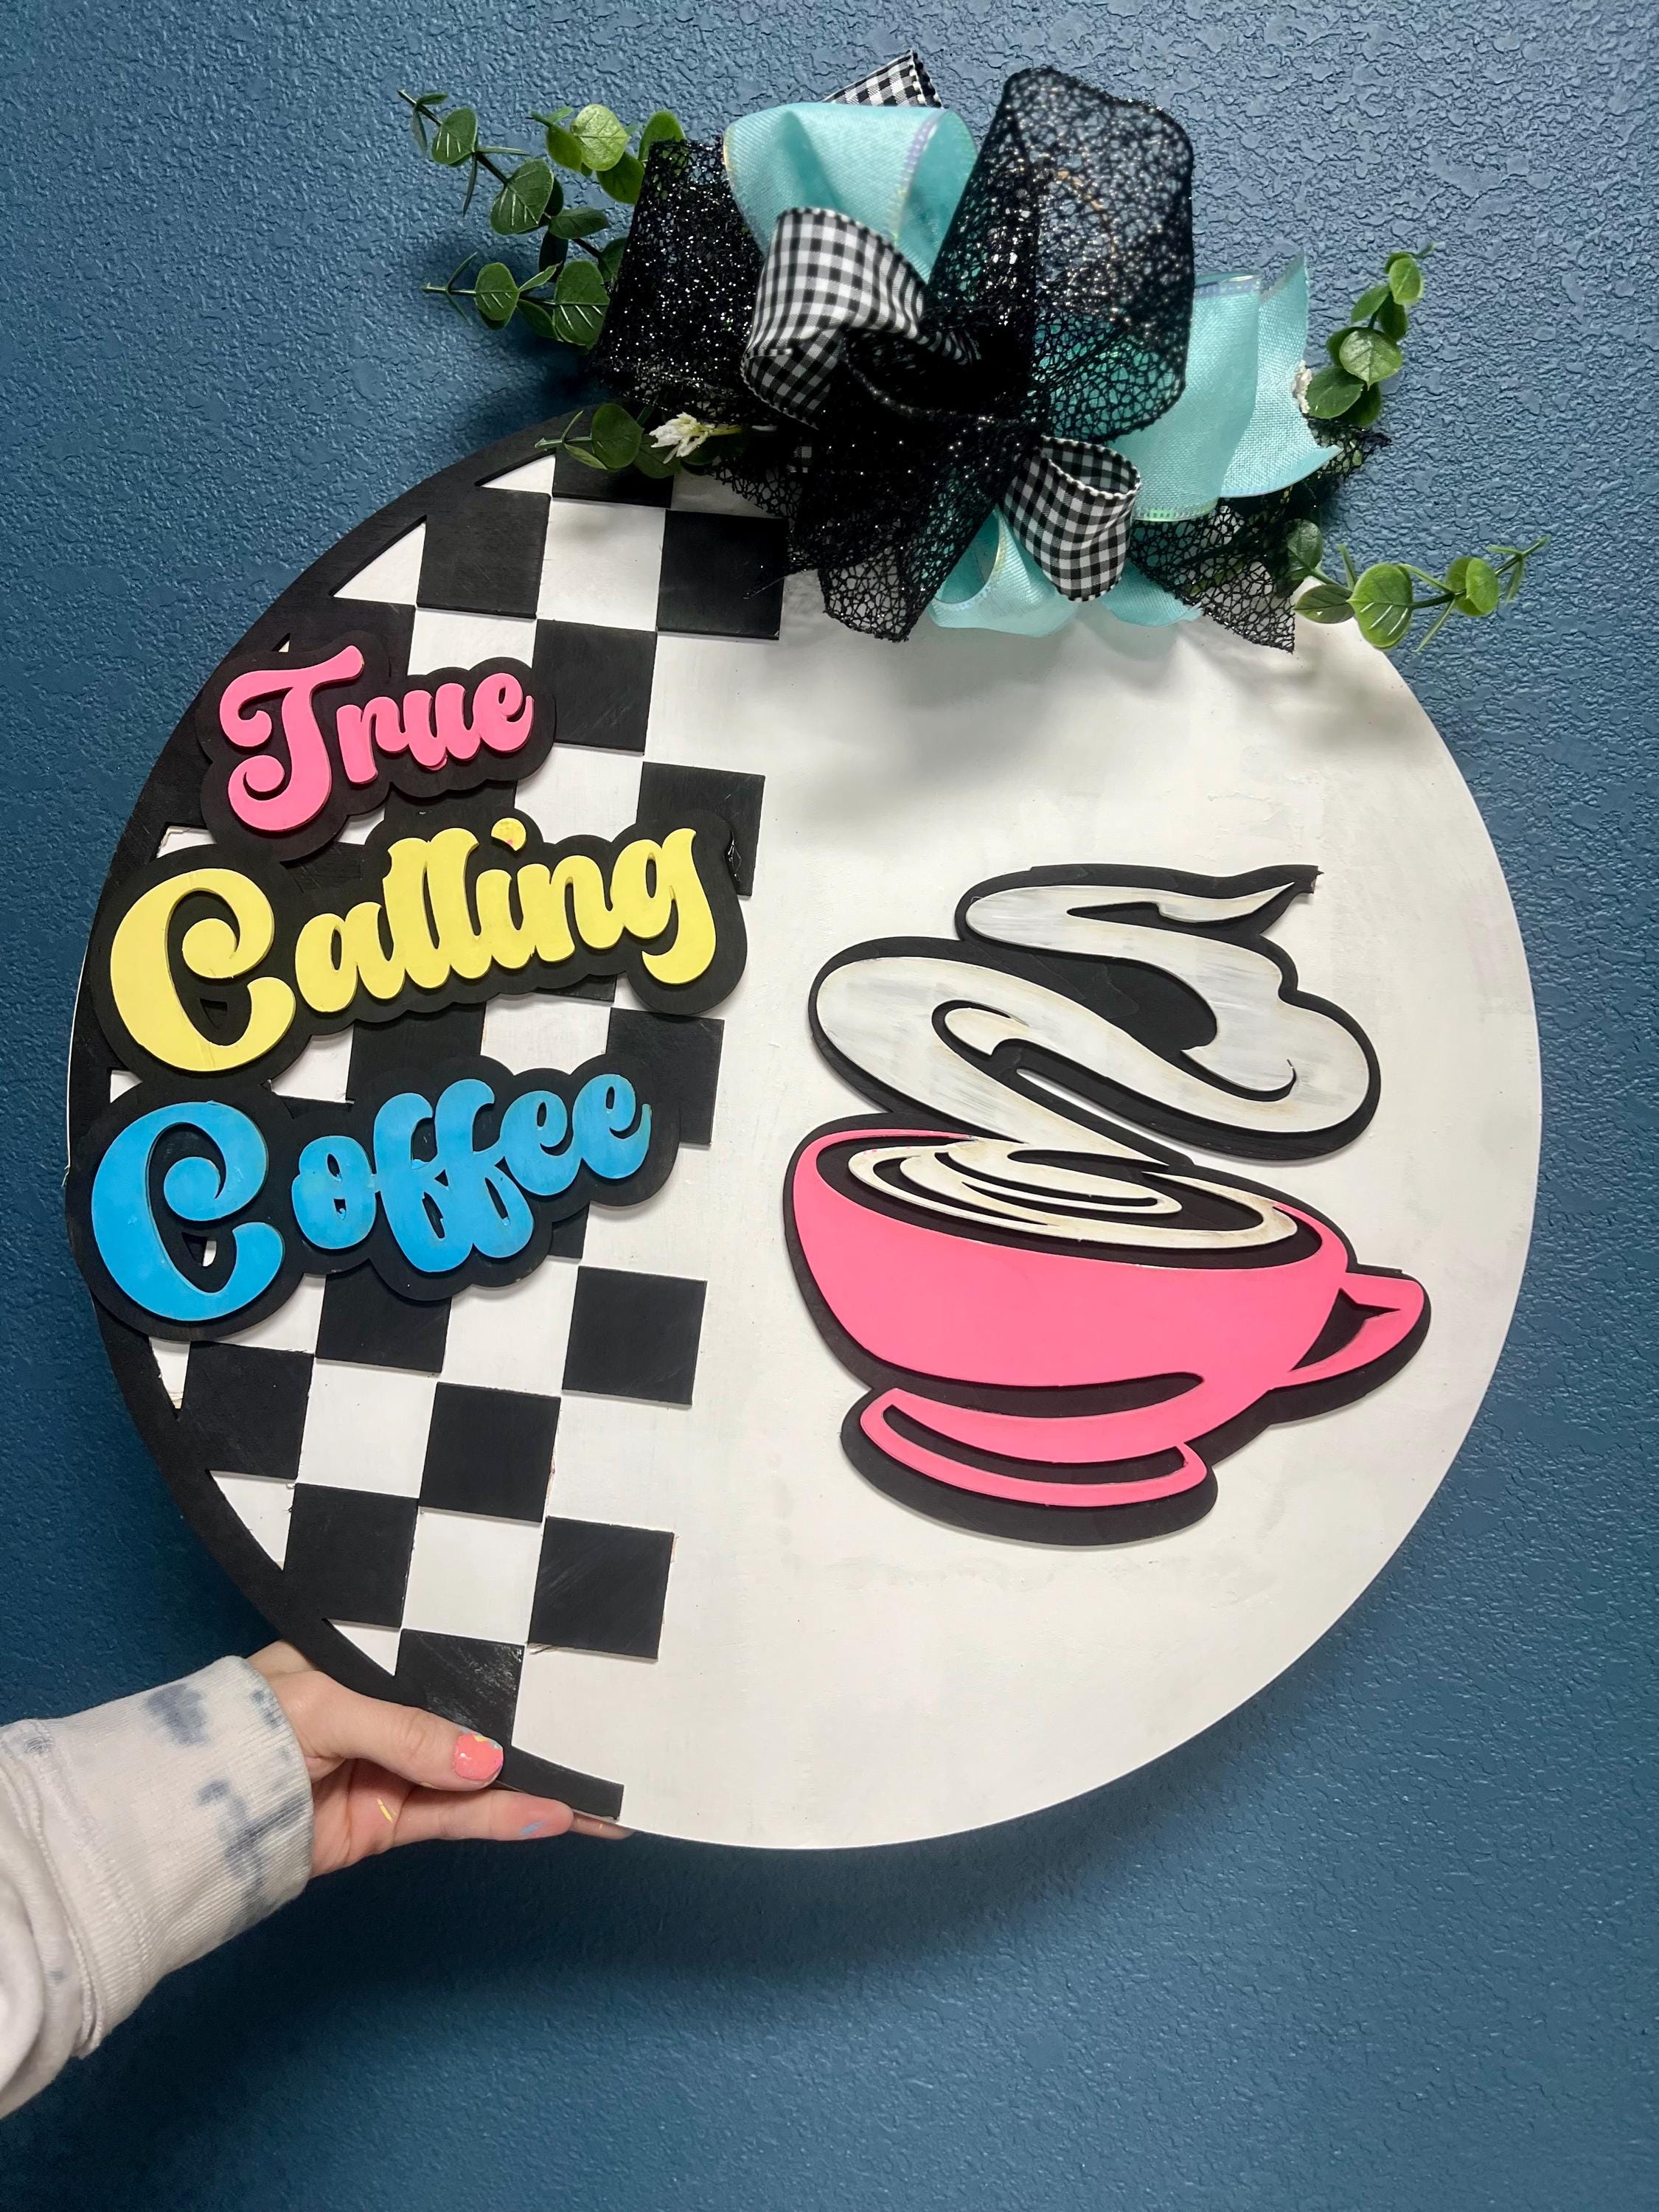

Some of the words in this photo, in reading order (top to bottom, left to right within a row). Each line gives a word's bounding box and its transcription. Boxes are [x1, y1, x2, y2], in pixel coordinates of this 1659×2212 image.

[219, 644, 535, 832] True
[110, 817, 717, 1073] Calling
[91, 1074, 651, 1321] Coffee
